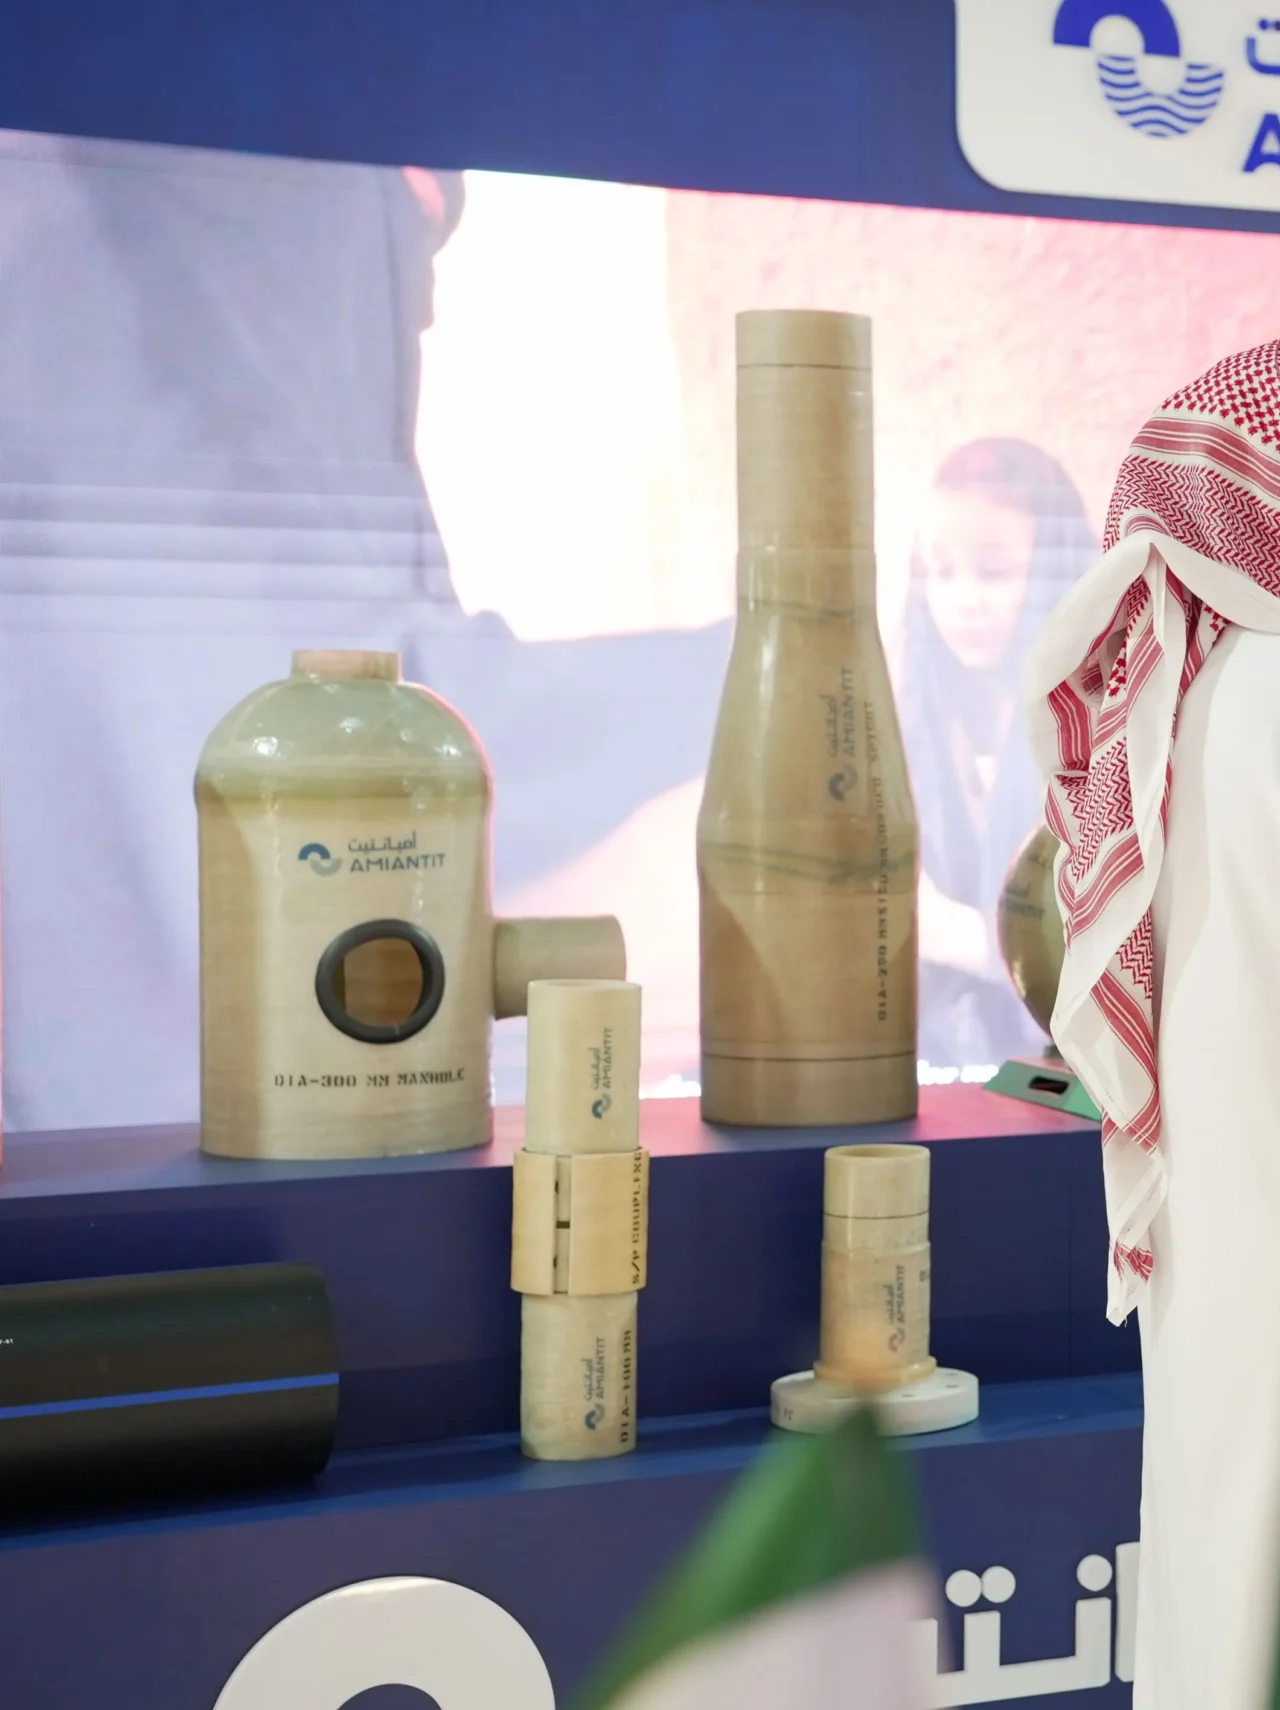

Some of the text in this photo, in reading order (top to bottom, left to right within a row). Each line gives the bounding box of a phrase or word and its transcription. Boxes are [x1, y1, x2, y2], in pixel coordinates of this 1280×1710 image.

[841, 665, 855, 757] AMIANTIT
[350, 853, 446, 873] AMIANTIT
[274, 1074, 357, 1088] DIA-300
[366, 1074, 390, 1088] MM
[602, 1026, 613, 1090] AMIANTIT
[595, 1336, 605, 1399] AMIANTIT
